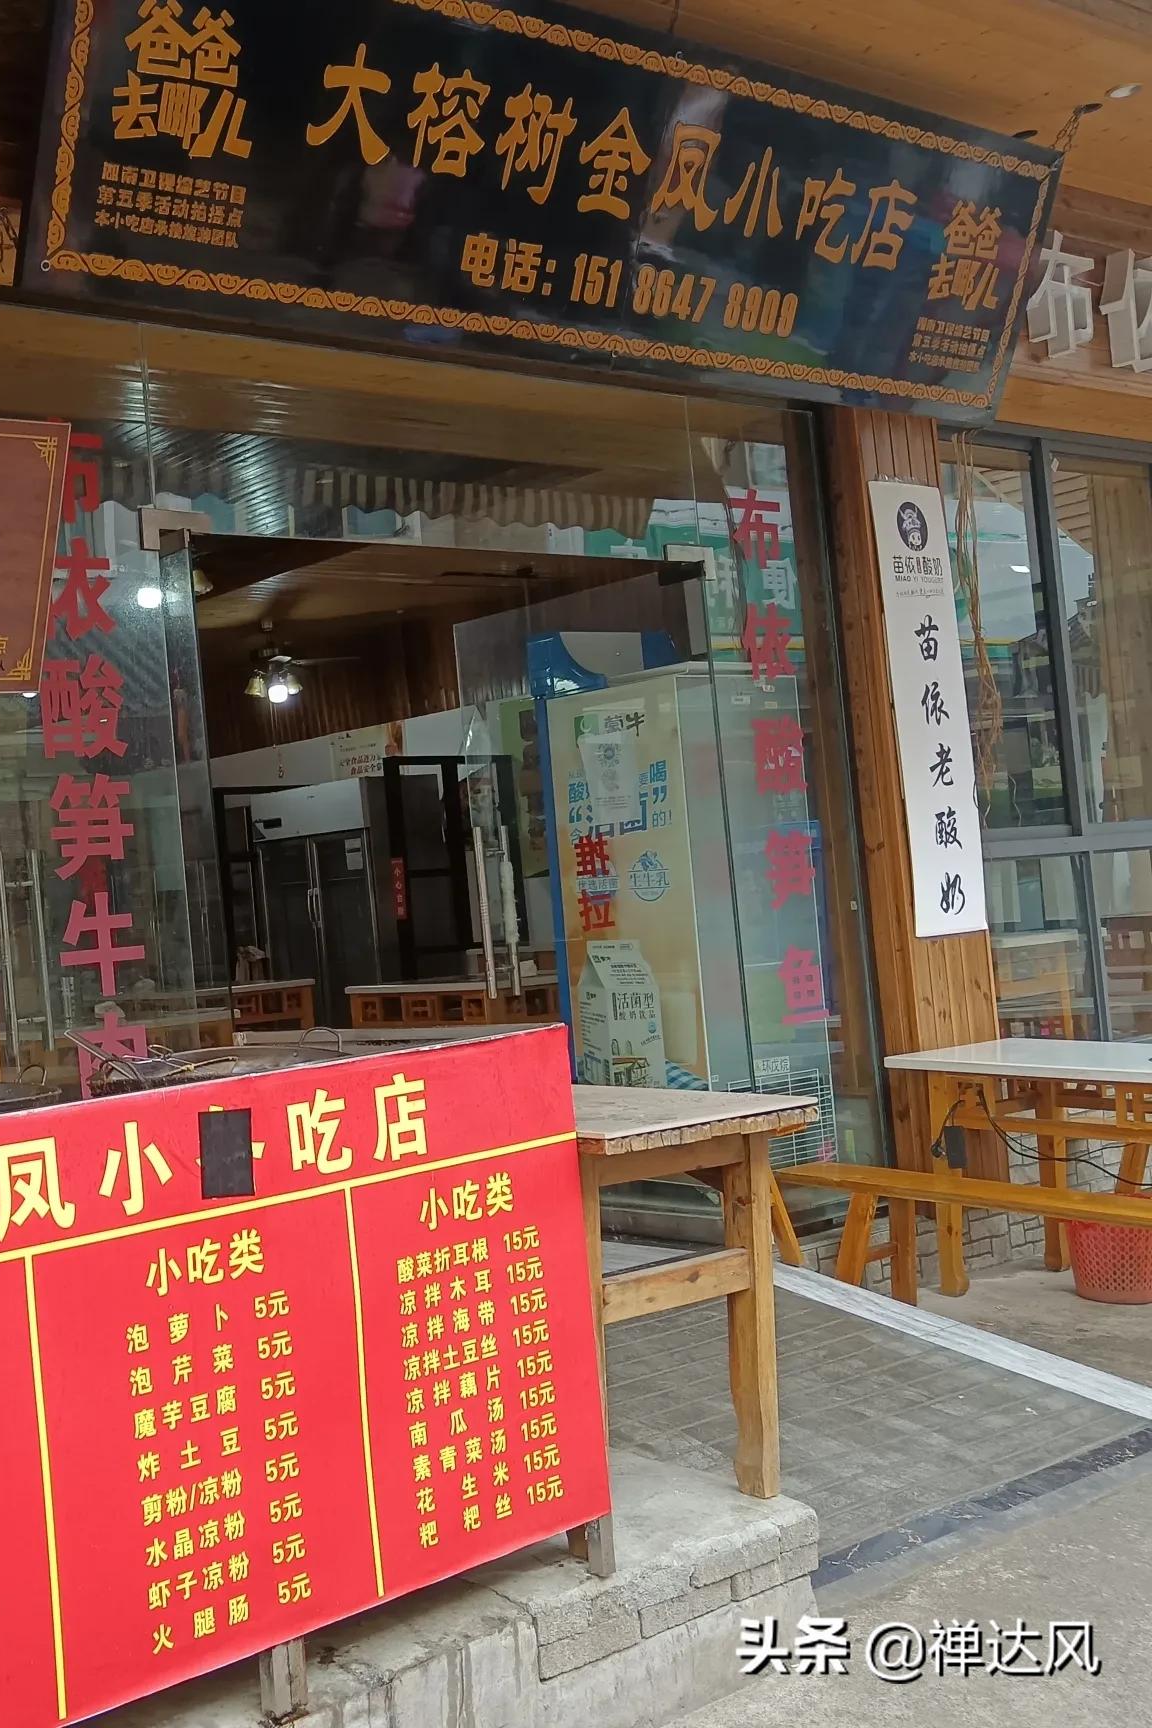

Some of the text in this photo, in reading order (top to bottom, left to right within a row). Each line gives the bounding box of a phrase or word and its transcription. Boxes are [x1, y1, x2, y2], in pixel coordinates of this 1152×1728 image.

[125, 0, 242, 89] 爸爸
[112, 69, 253, 160] 去哪儿
[306, 43, 918, 272] 大榕树金凤小吃店
[97, 185, 243, 228] 第五季活动拍摄点
[944, 200, 1002, 260] 爸爸
[570, 253, 623, 309] 151
[633, 263, 717, 325] 8647
[723, 282, 799, 339] 8909
[927, 253, 999, 311] 去哪儿
[604, 711, 645, 737] 蒙牛
[914, 614, 966, 916] 苗依老酸奶
[578, 888, 615, 932] 拉
[419, 1171, 514, 1231] 小吃类
[145, 1229, 265, 1297] 小吃类
[397, 1225, 540, 1285] 酸菜折耳根 15元
[399, 1256, 544, 1317] 凉拌木耳 15元
[126, 1289, 290, 1355] 泡萝卜 5元
[401, 1287, 548, 1349] 凉拌海带 15元
[403, 1319, 549, 1382] 凉拌土豆丝 15元
[129, 1330, 293, 1397] 泡芹菜 5元
[406, 1349, 553, 1416] 凉拌藕片 15元
[133, 1370, 296, 1440] 魔芋豆腐 5元
[409, 1381, 556, 1447] 南瓜汤 15元
[137, 1410, 299, 1484] 炸土豆 5元
[412, 1412, 557, 1483] 素青菜汤 15元
[416, 1443, 560, 1515] 花生米 15元
[141, 1451, 300, 1528] 剪粉/凉粉 5元
[419, 1475, 564, 1549] 粑粑丝 15元
[146, 1492, 303, 1569] 水晶凉粉 5元
[148, 1533, 307, 1612] 虾子凉粉 5元
[151, 1573, 312, 1655] 火腿肠 5元
